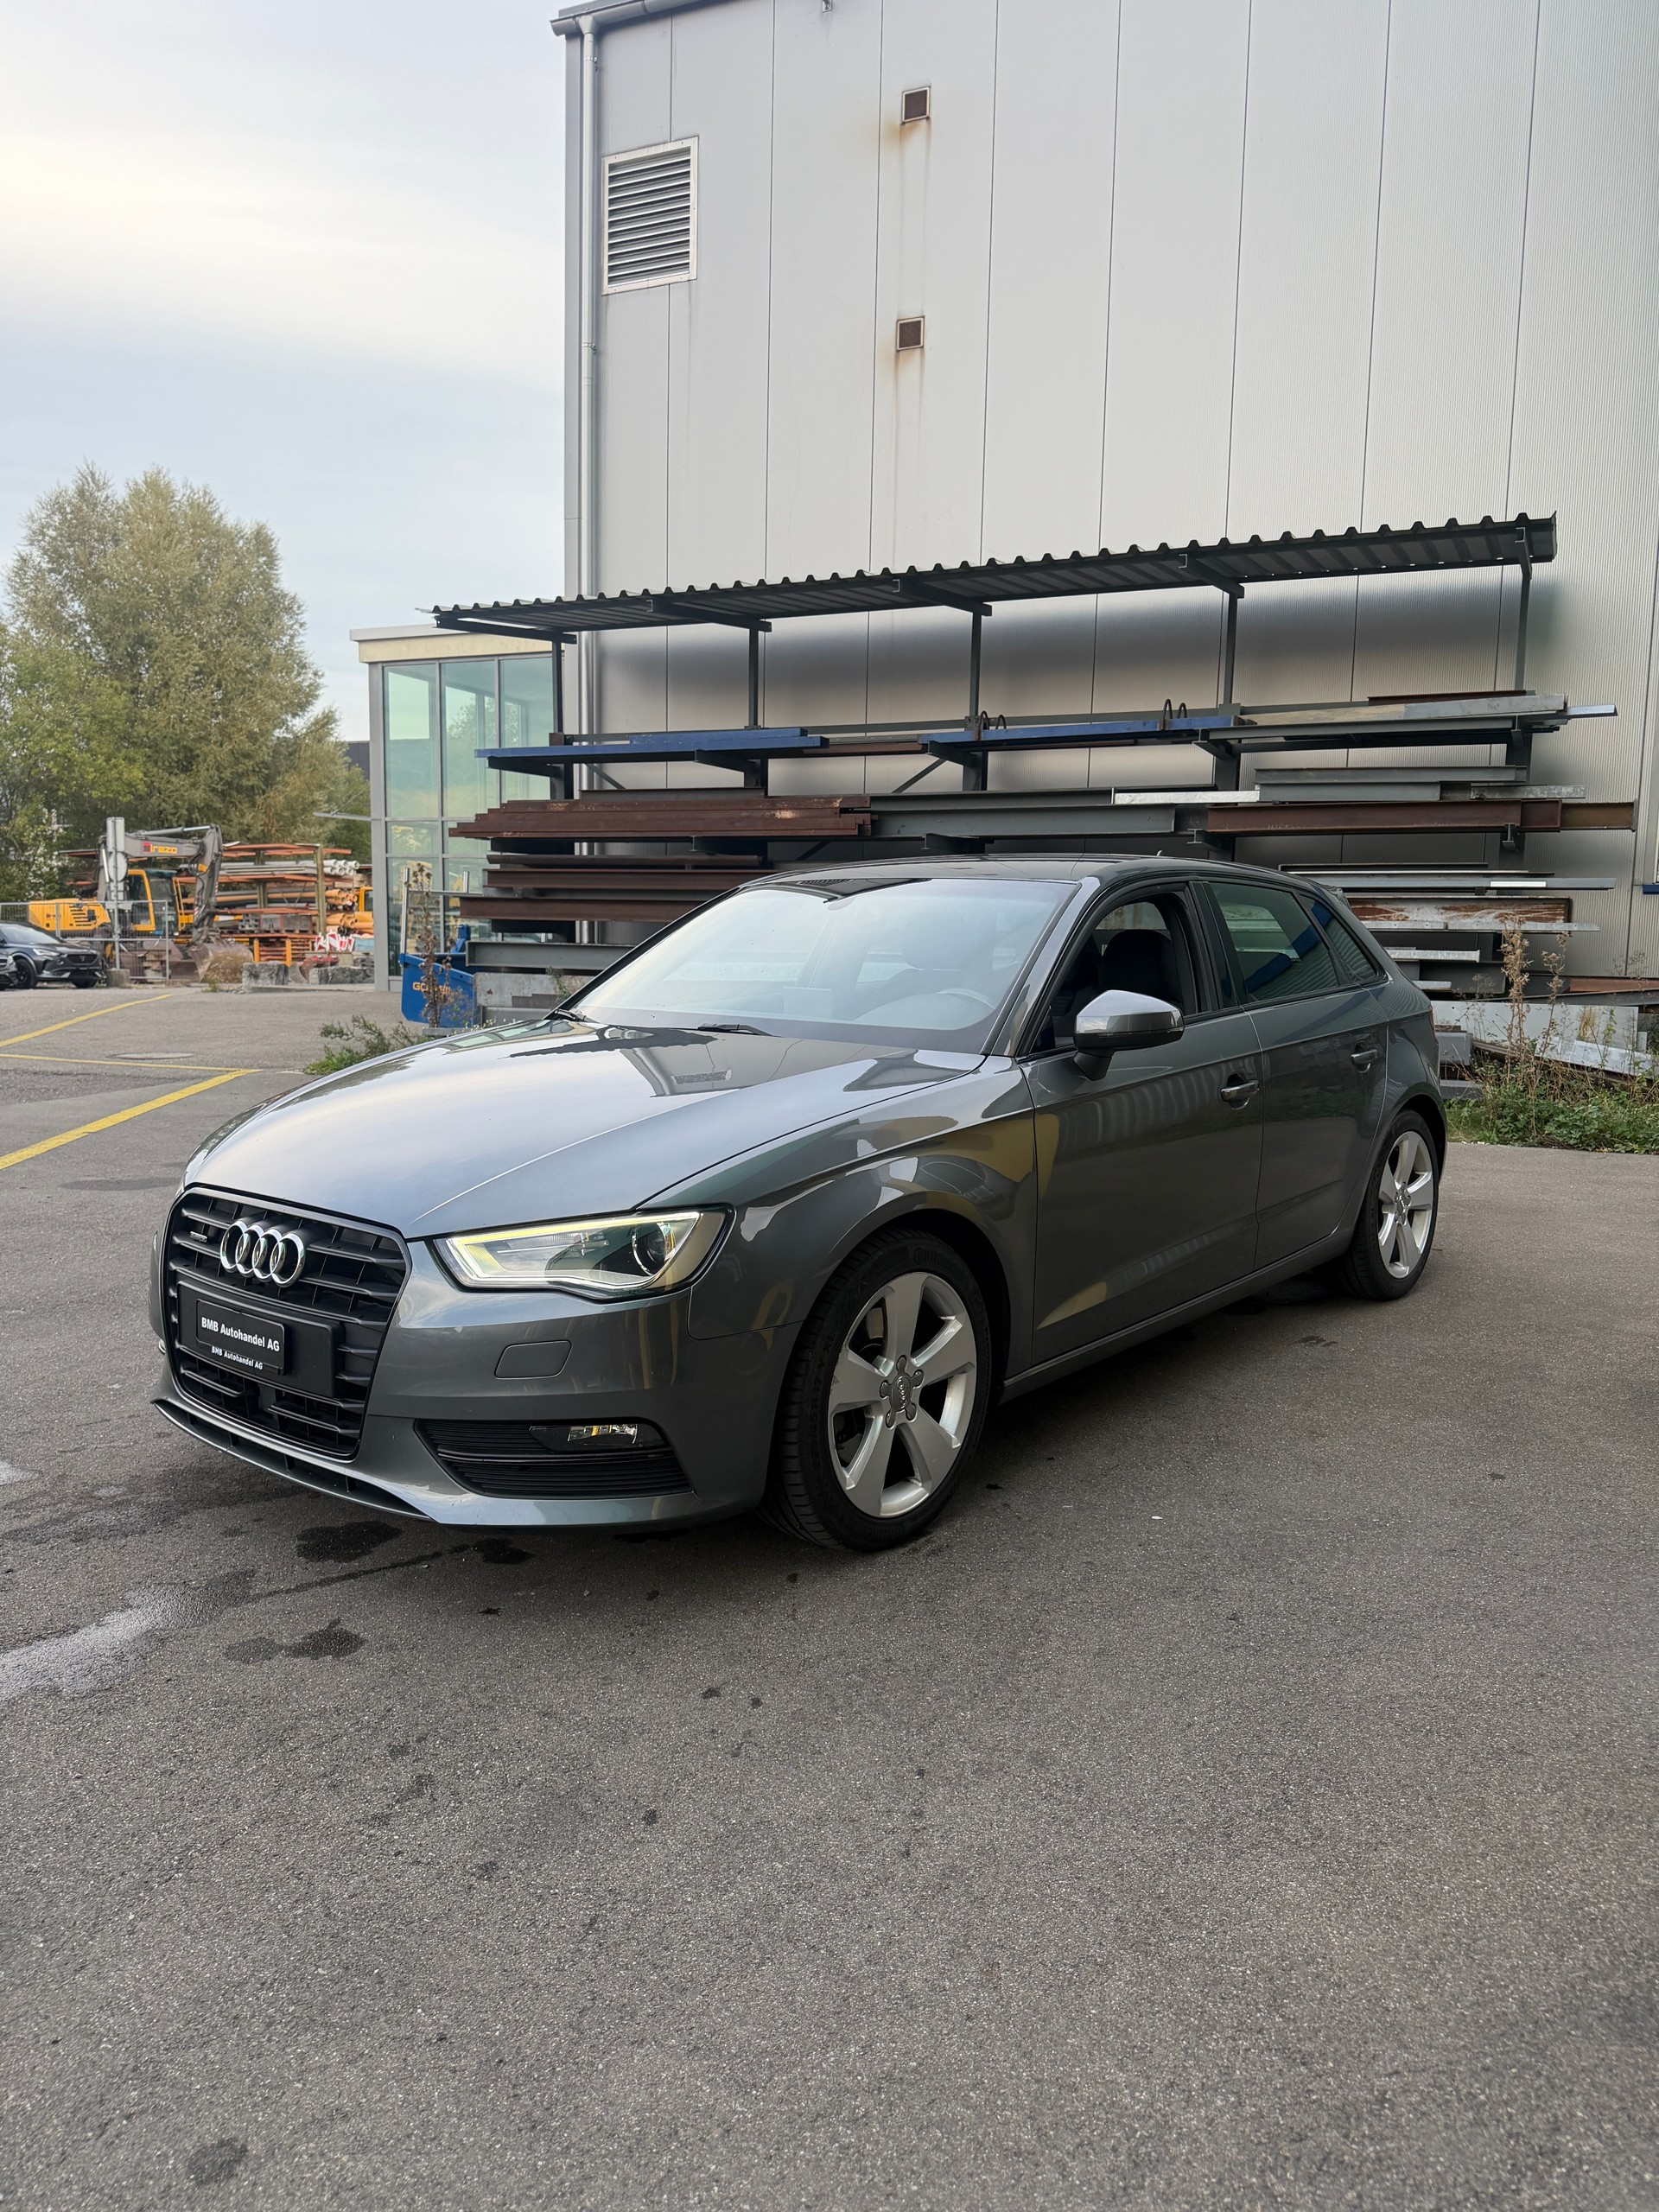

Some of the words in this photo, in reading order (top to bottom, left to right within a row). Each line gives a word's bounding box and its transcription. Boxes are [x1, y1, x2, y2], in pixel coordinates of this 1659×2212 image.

[200, 1317, 219, 1332] BMB
[219, 1323, 265, 1348] Autohandel
[267, 1338, 280, 1352] AG
[211, 1345, 223, 1357] BMB
[223, 1351, 254, 1367] Autohandel
[254, 1360, 264, 1370] AG
